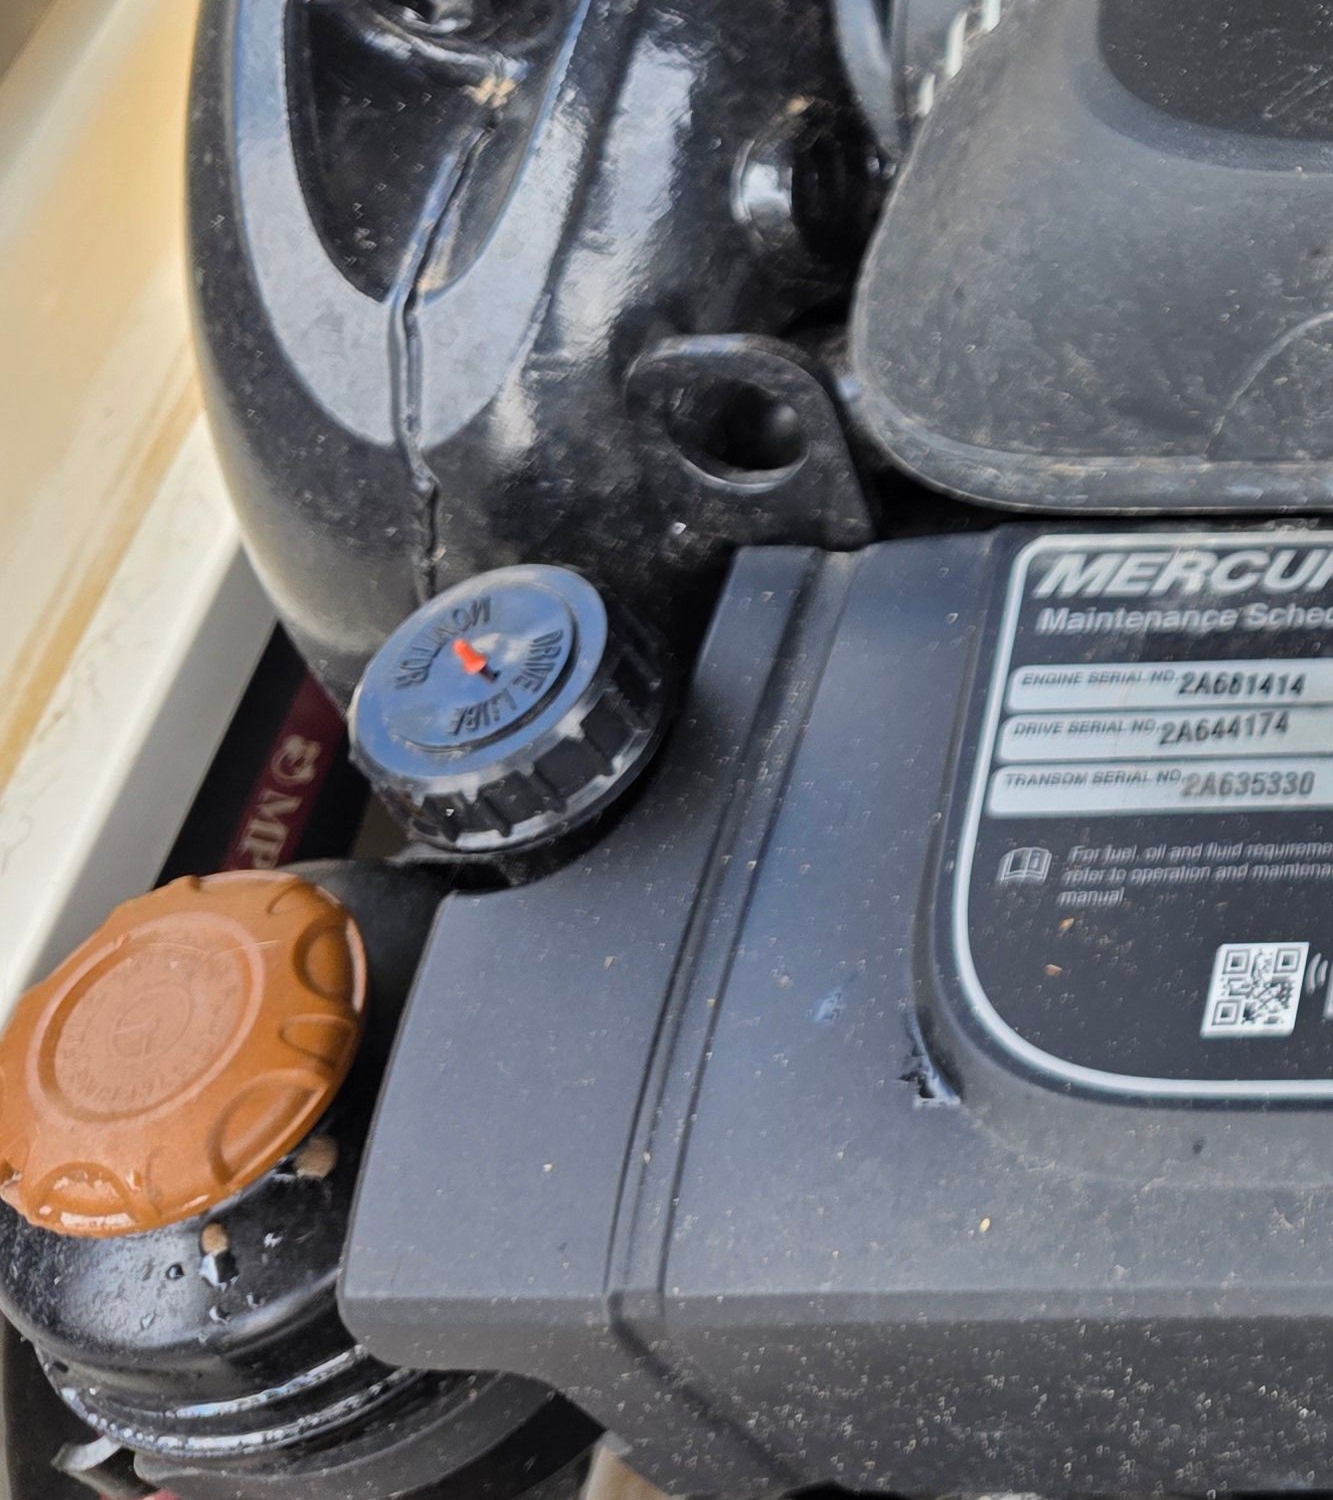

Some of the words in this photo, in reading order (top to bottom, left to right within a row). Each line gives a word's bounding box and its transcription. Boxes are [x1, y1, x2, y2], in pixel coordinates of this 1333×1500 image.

[1037, 605, 1237, 634] Maintenance
[1021, 672, 1084, 685] ENGINE
[1087, 670, 1144, 684] SERIAL
[1151, 669, 1178, 682] NO.
[1014, 721, 1063, 736] DRIVE
[1068, 720, 1126, 733] SERIAL
[1131, 718, 1159, 733] NO.
[1159, 712, 1290, 745] 2A644174
[1004, 772, 1088, 787] TRANSOM
[1092, 771, 1152, 785] SERIAL
[1157, 769, 1185, 783] NO.
[1181, 771, 1314, 797] 2A635330
